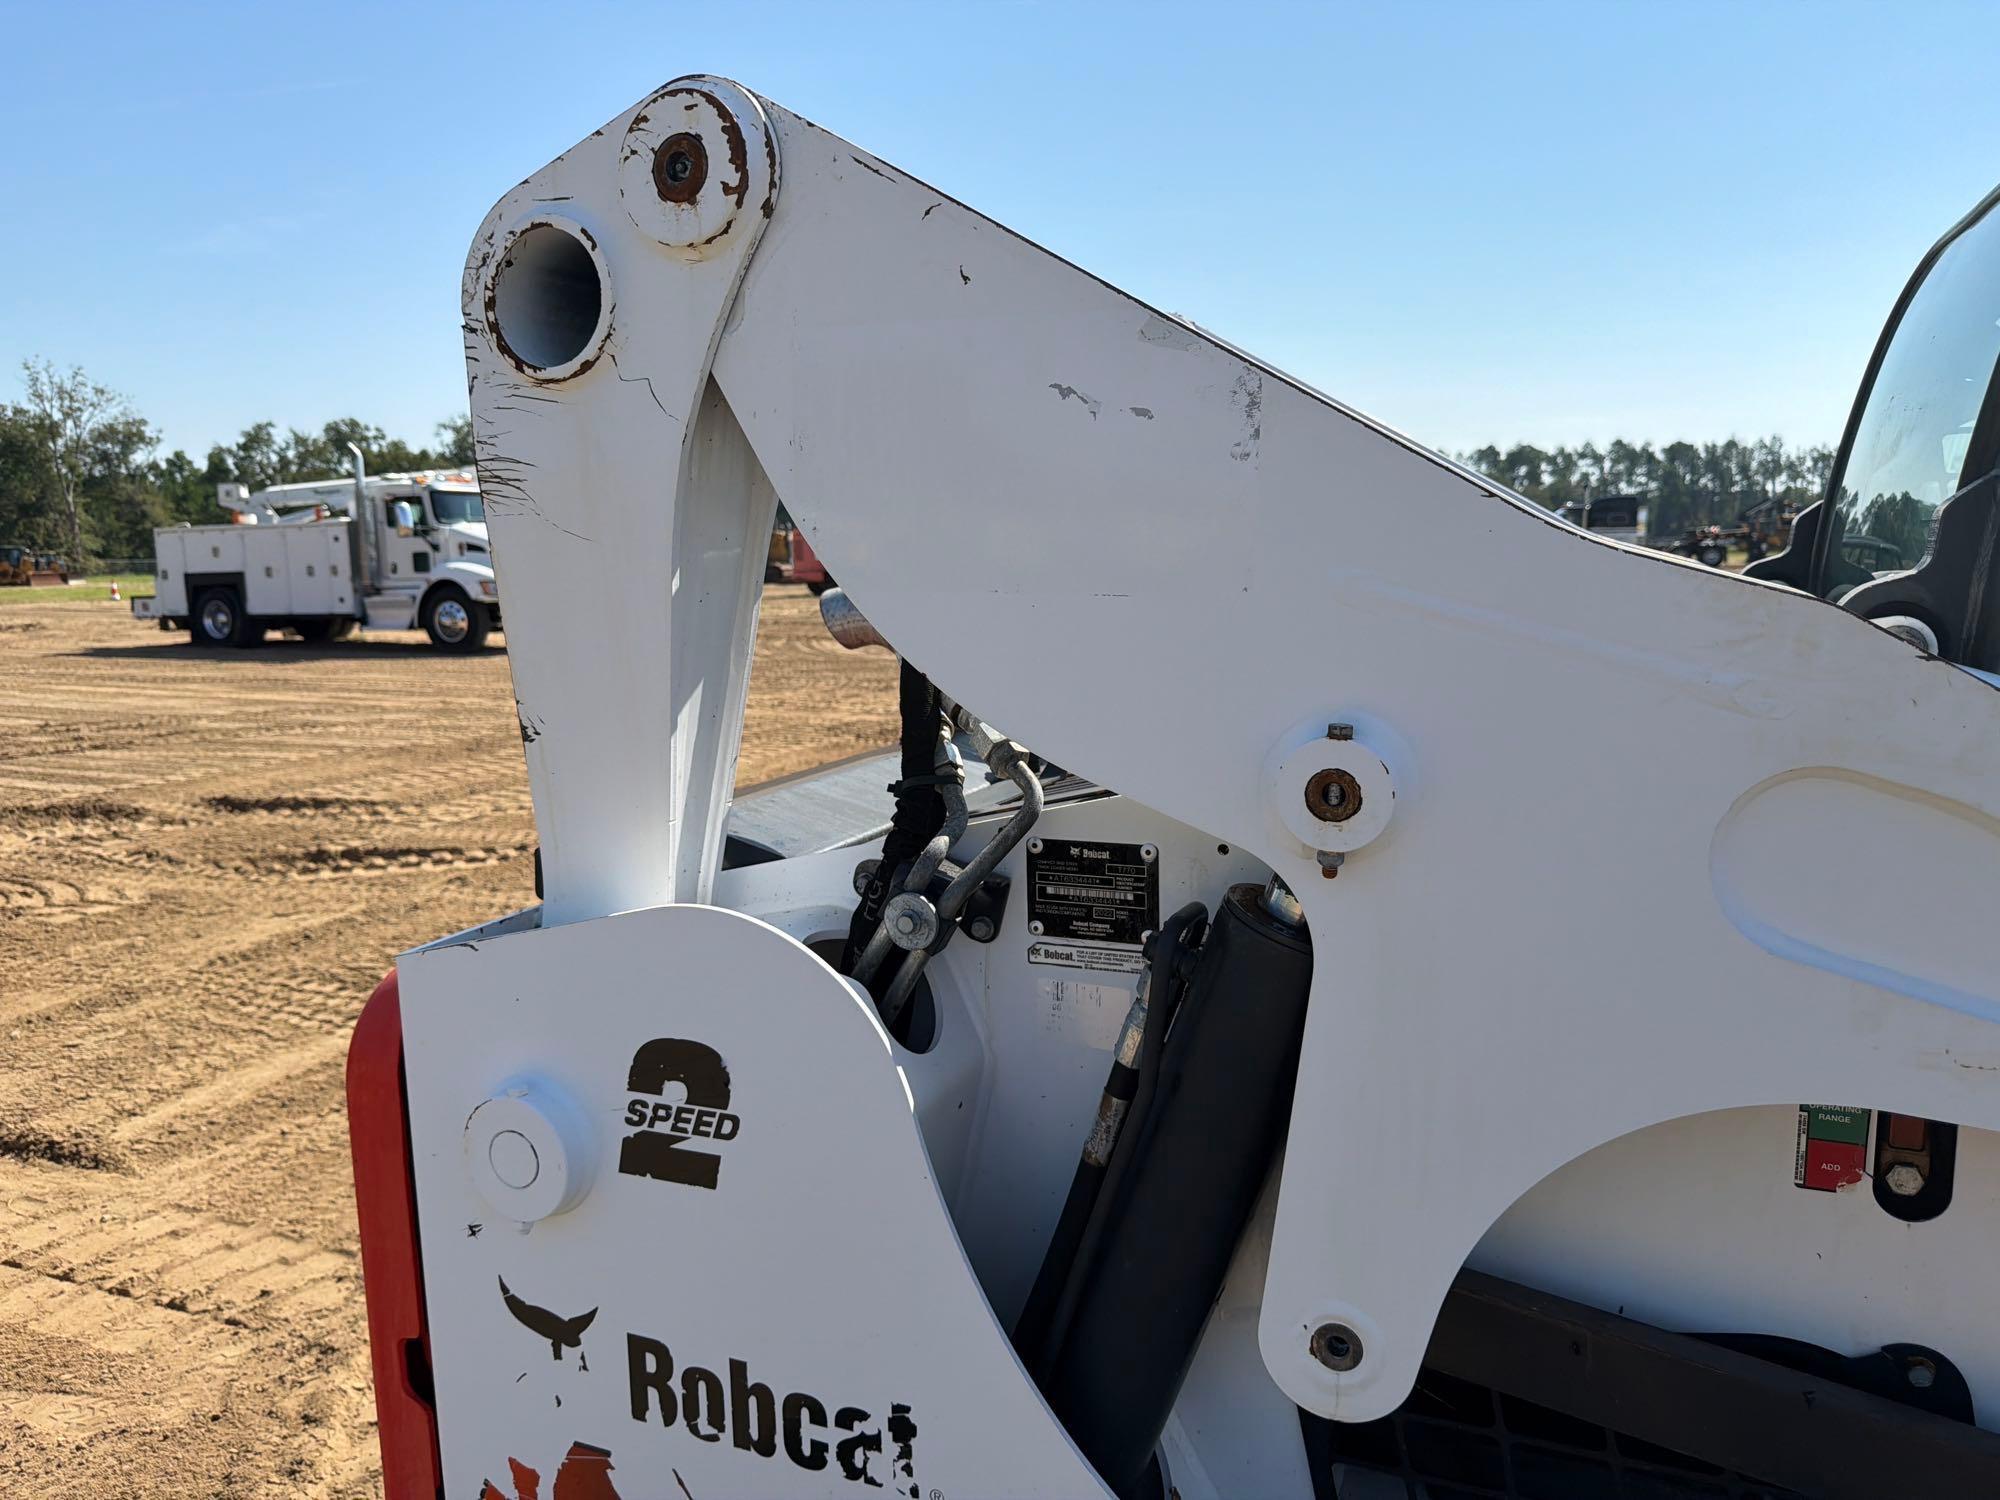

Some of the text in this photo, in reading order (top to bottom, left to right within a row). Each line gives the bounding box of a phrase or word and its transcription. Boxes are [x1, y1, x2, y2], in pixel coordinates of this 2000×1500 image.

[1083, 848, 1110, 859] Bobcat
[1044, 949, 1073, 961] Bobcat
[619, 1037, 731, 1190] 2
[1809, 1104, 1861, 1114] OPERATING
[624, 1098, 741, 1141] SPEED
[1818, 1113, 1851, 1123] RANGE
[1821, 1163, 1841, 1171] ADD
